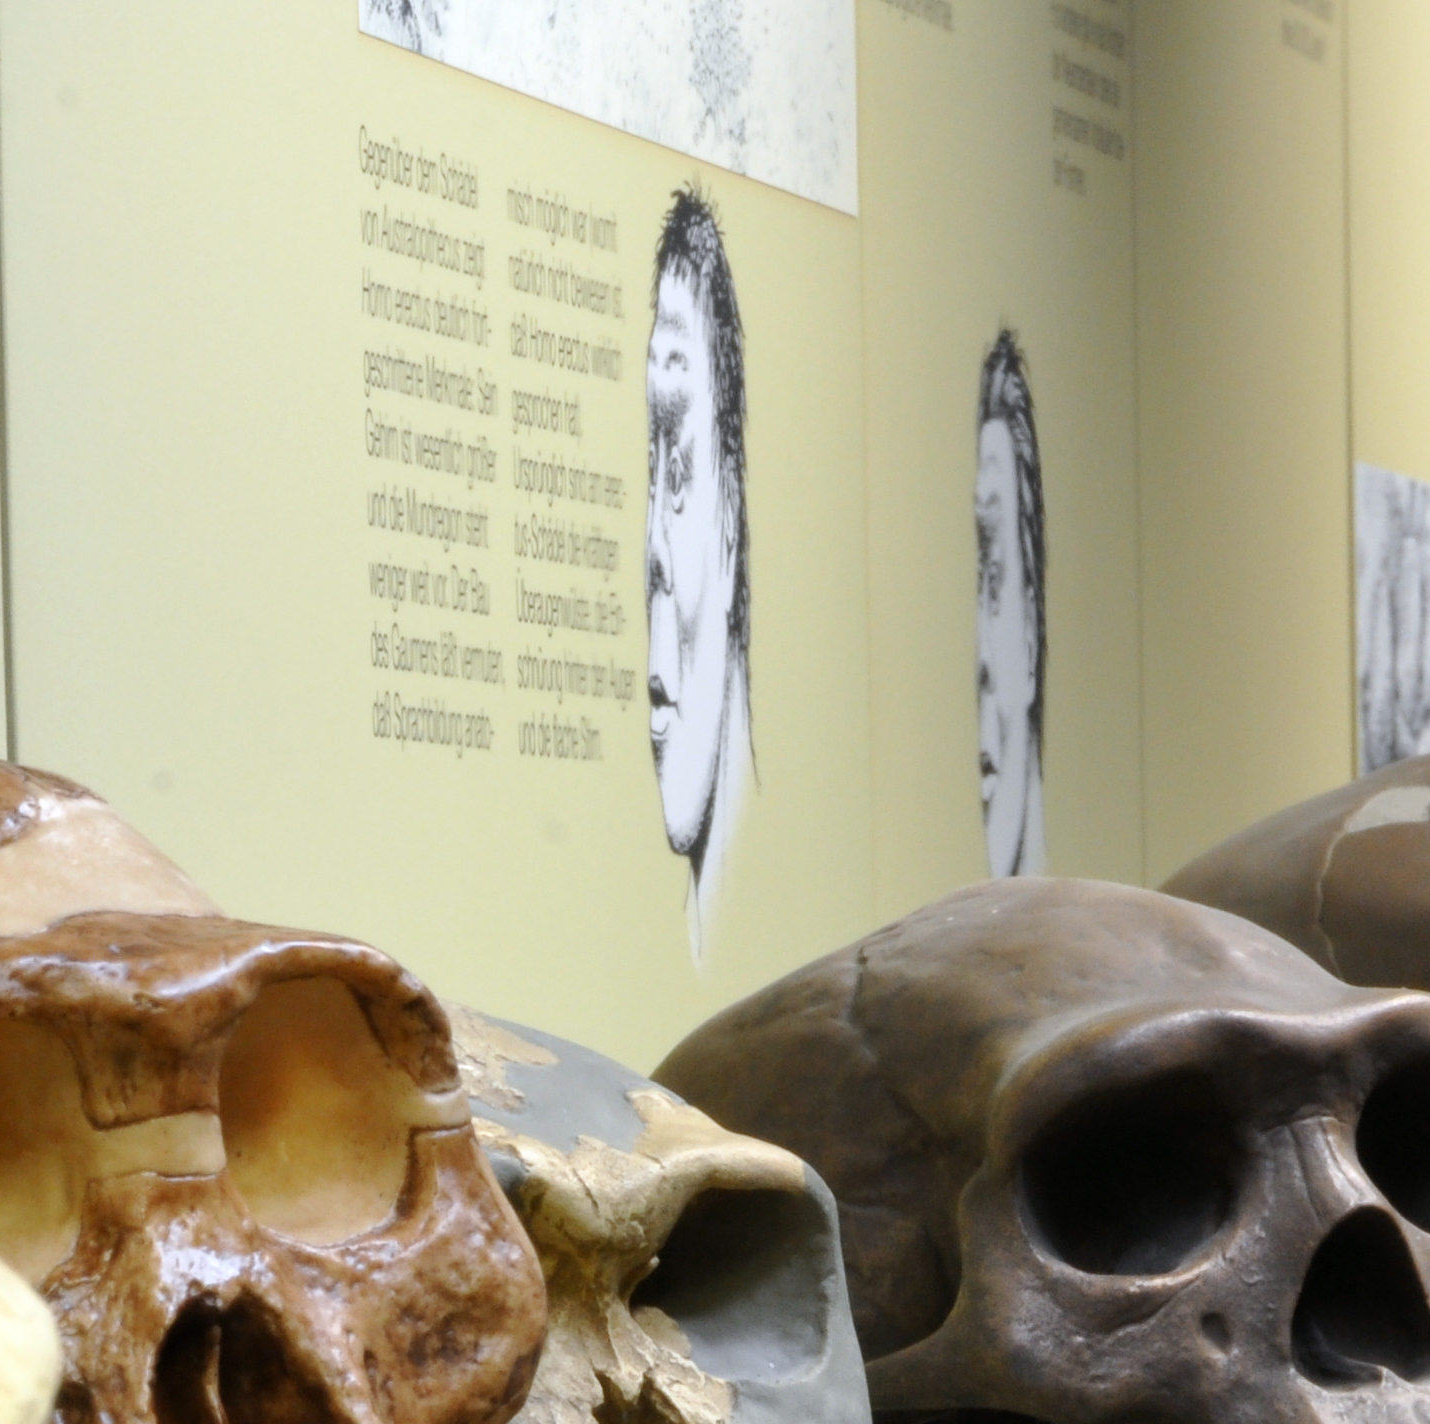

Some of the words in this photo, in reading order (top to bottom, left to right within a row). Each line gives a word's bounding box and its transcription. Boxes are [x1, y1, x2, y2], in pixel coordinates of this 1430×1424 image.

[359, 125, 413, 190] Gegenüber
[416, 147, 438, 196] dem
[360, 208, 379, 248] von
[362, 267, 391, 322] Homo
[395, 285, 431, 331] erectus
[529, 316, 556, 366] Homo
[367, 482, 386, 529] und
[389, 484, 403, 533] die
[368, 553, 407, 613] weniger
[451, 564, 469, 611] Der
[470, 567, 490, 616] Bau
[370, 621, 389, 669] des
[391, 622, 438, 676] Gaumens
[372, 691, 391, 739] daß
[518, 712, 536, 756] und
